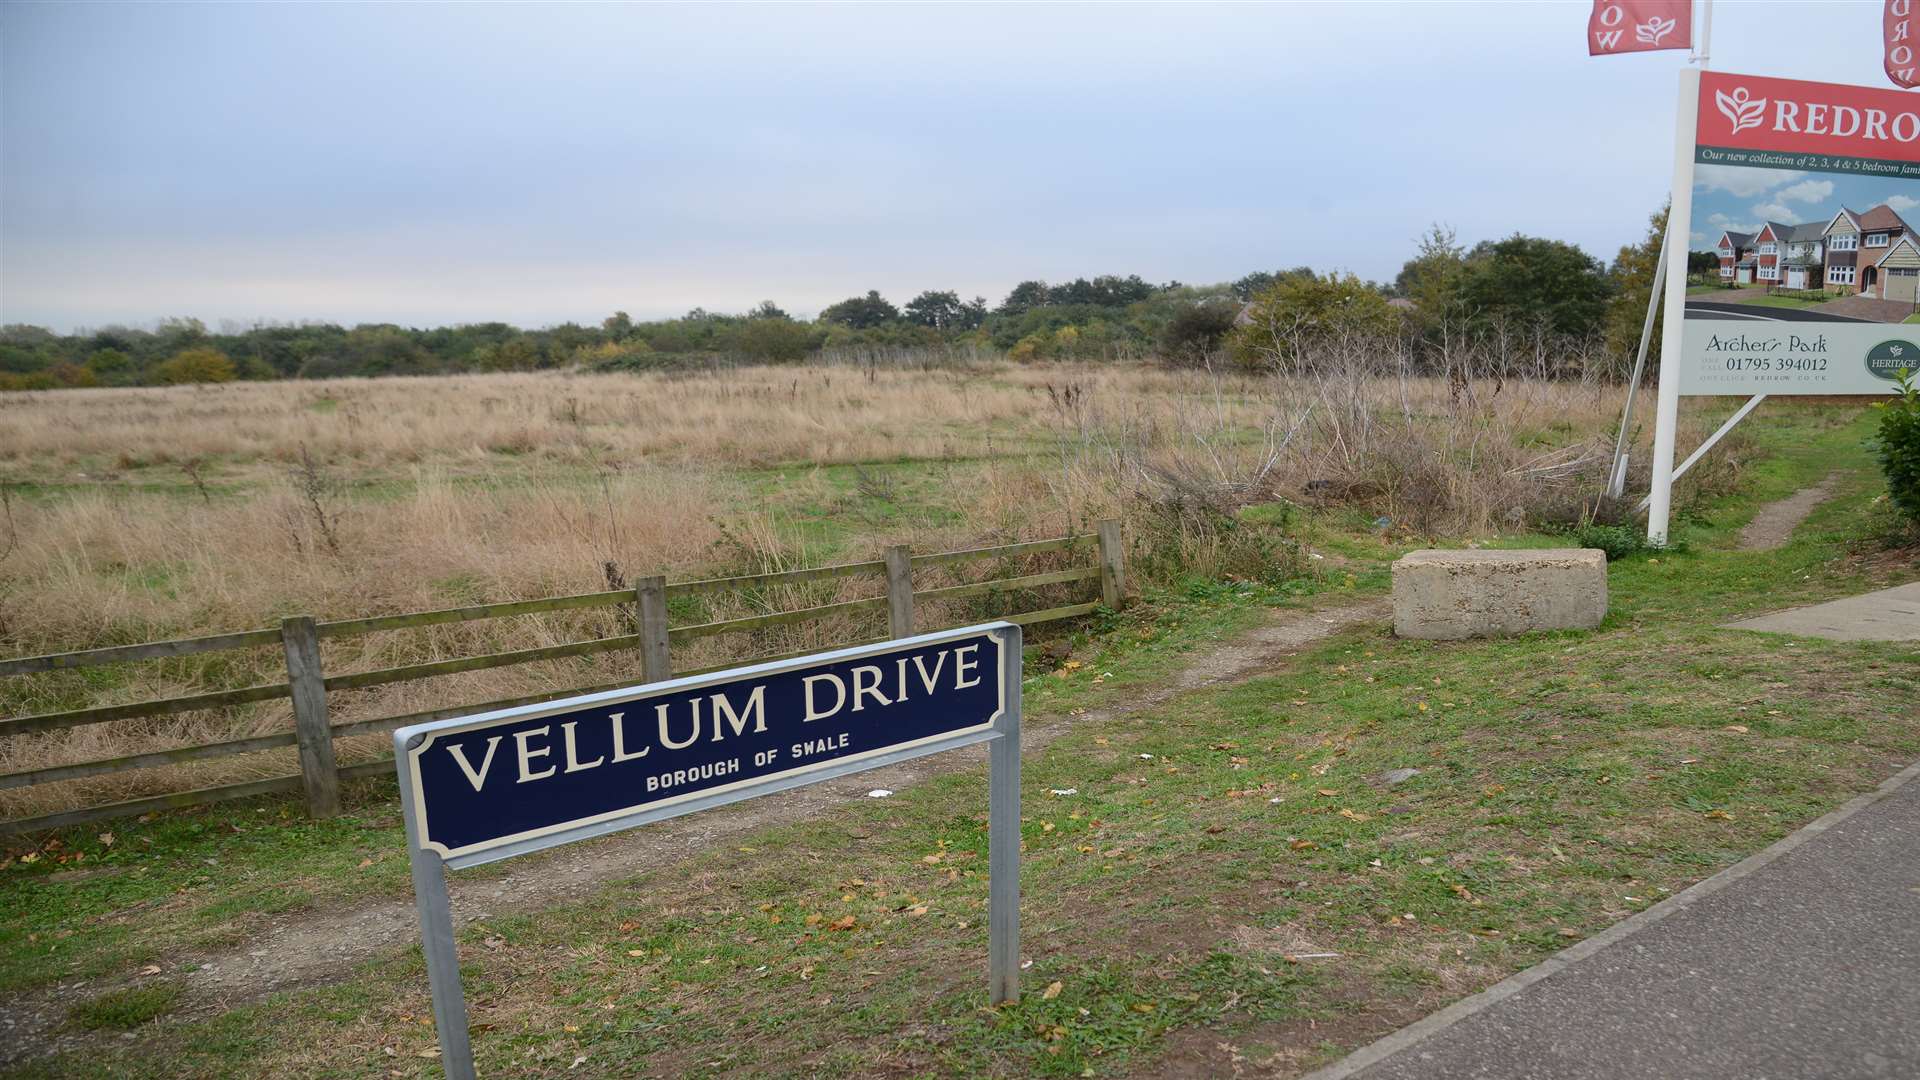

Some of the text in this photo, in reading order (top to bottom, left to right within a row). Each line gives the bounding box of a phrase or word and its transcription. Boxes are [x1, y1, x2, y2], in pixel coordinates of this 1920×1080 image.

[1595, 0, 1625, 49] OW
[1772, 99, 1920, 143] REDRO
[1702, 149, 1724, 160] Our
[1727, 152, 1747, 161] new
[1749, 153, 1794, 165] collection
[1796, 156, 1807, 168] of
[1833, 159, 1840, 169] 4
[1842, 160, 1852, 169] &
[1853, 160, 1860, 169] 5
[1862, 160, 1899, 172] bedroom
[1788, 334, 1828, 352] Park
[1726, 357, 1771, 371] 01795
[1775, 358, 1828, 371] 394012
[1872, 359, 1917, 368] HERITAGE
[446, 643, 982, 793] VELLUM DRIVE
[646, 732, 851, 793] BOROUGH OF SWALE
